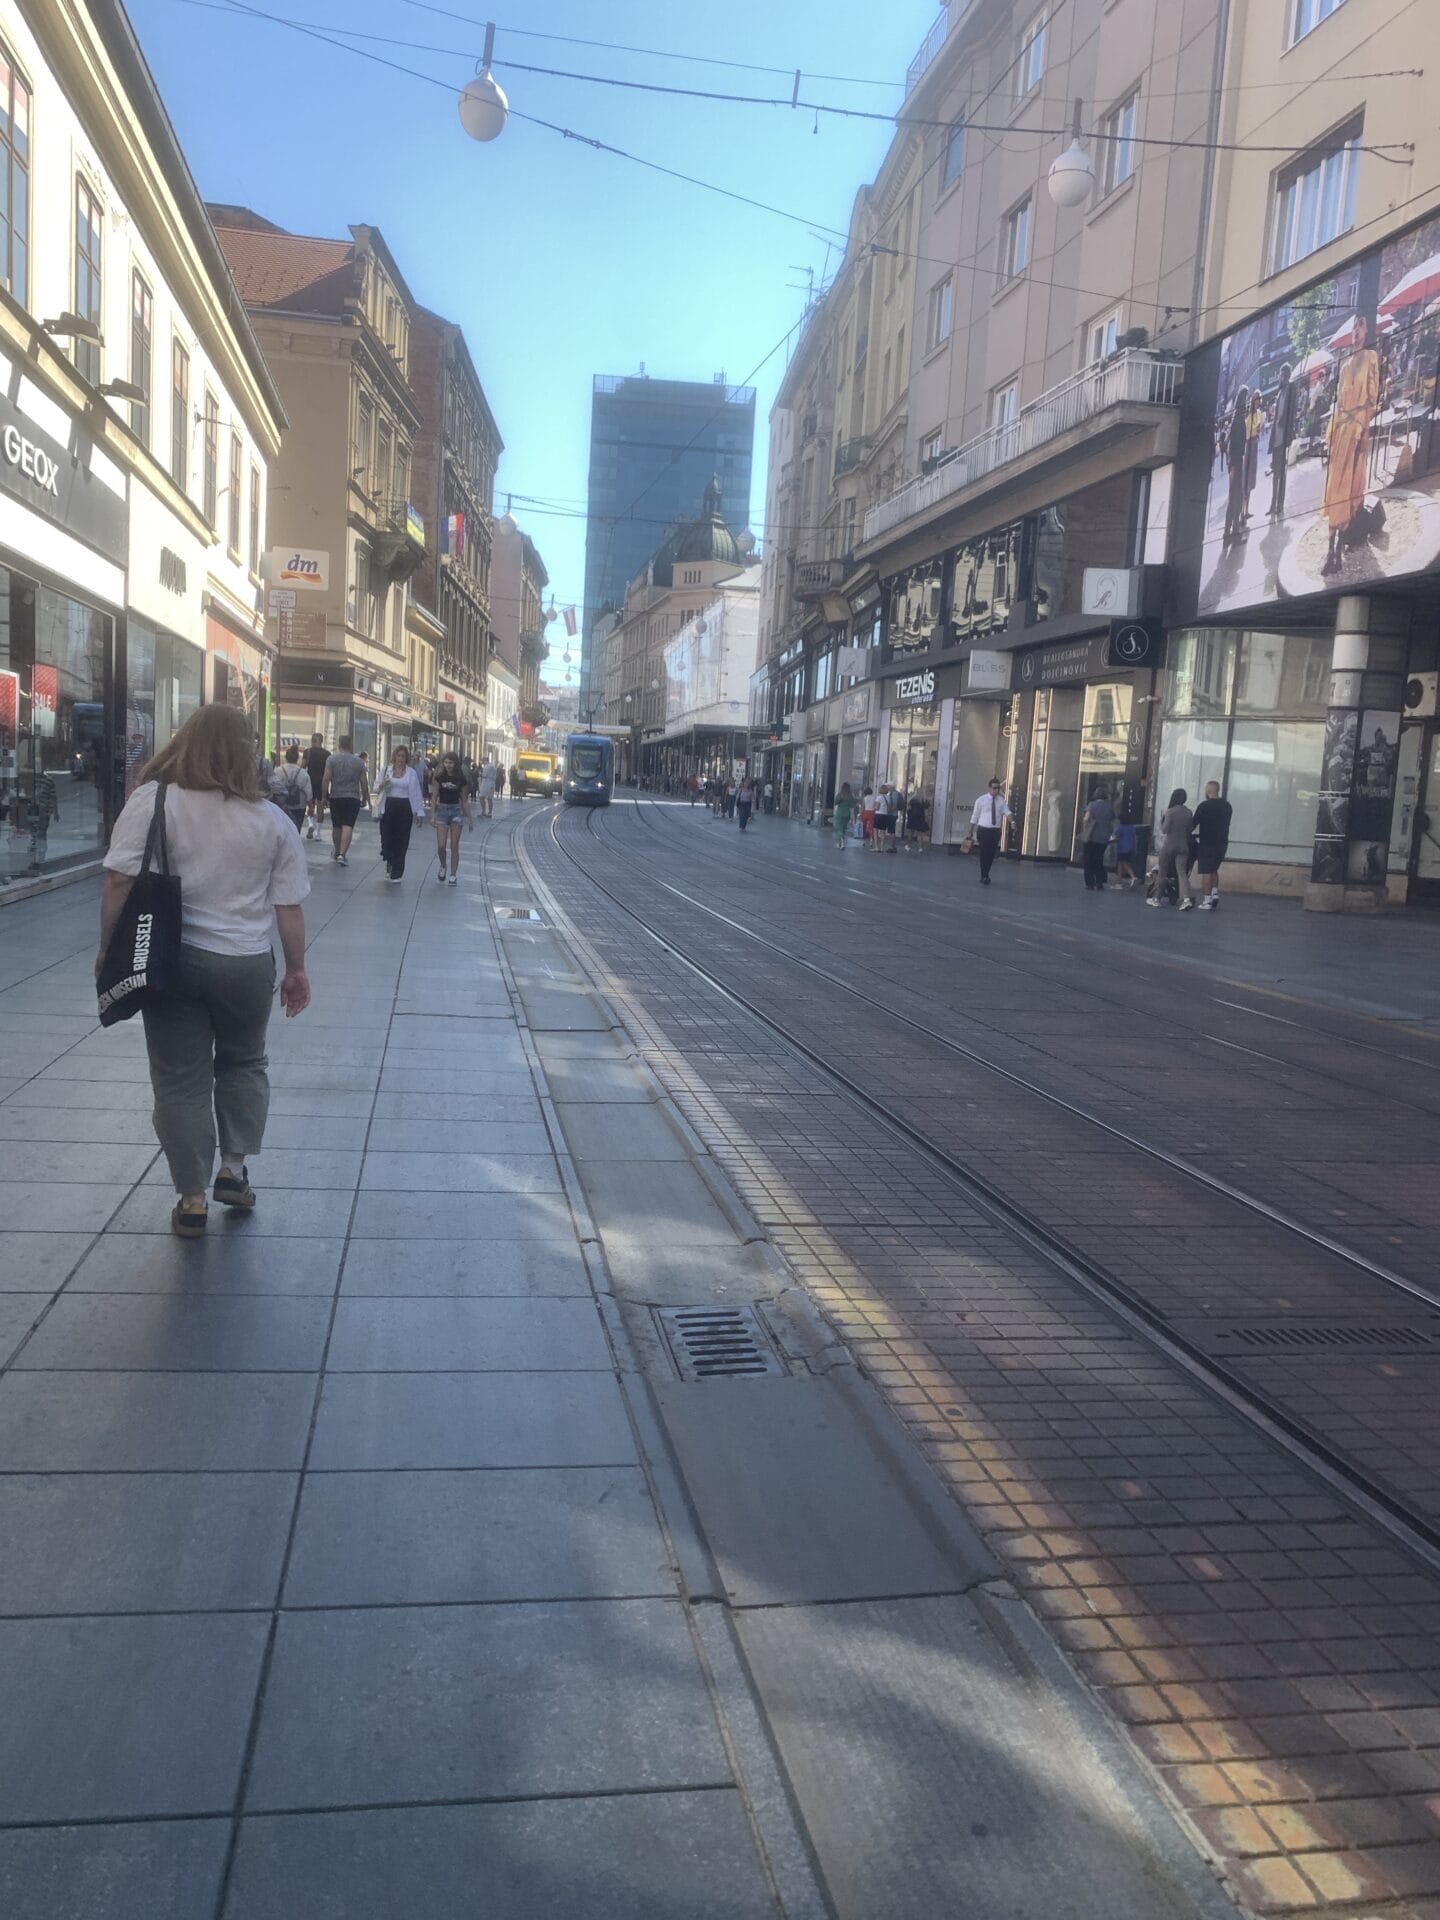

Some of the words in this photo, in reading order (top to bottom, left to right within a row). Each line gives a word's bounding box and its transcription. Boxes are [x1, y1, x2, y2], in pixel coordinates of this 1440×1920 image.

[5, 425, 59, 496] GEOX
[287, 554, 318, 573] dm
[896, 668, 935, 698] TEZENIS
[109, 972, 147, 1001] MUSEUM
[133, 913, 153, 972] BRUSSELS
